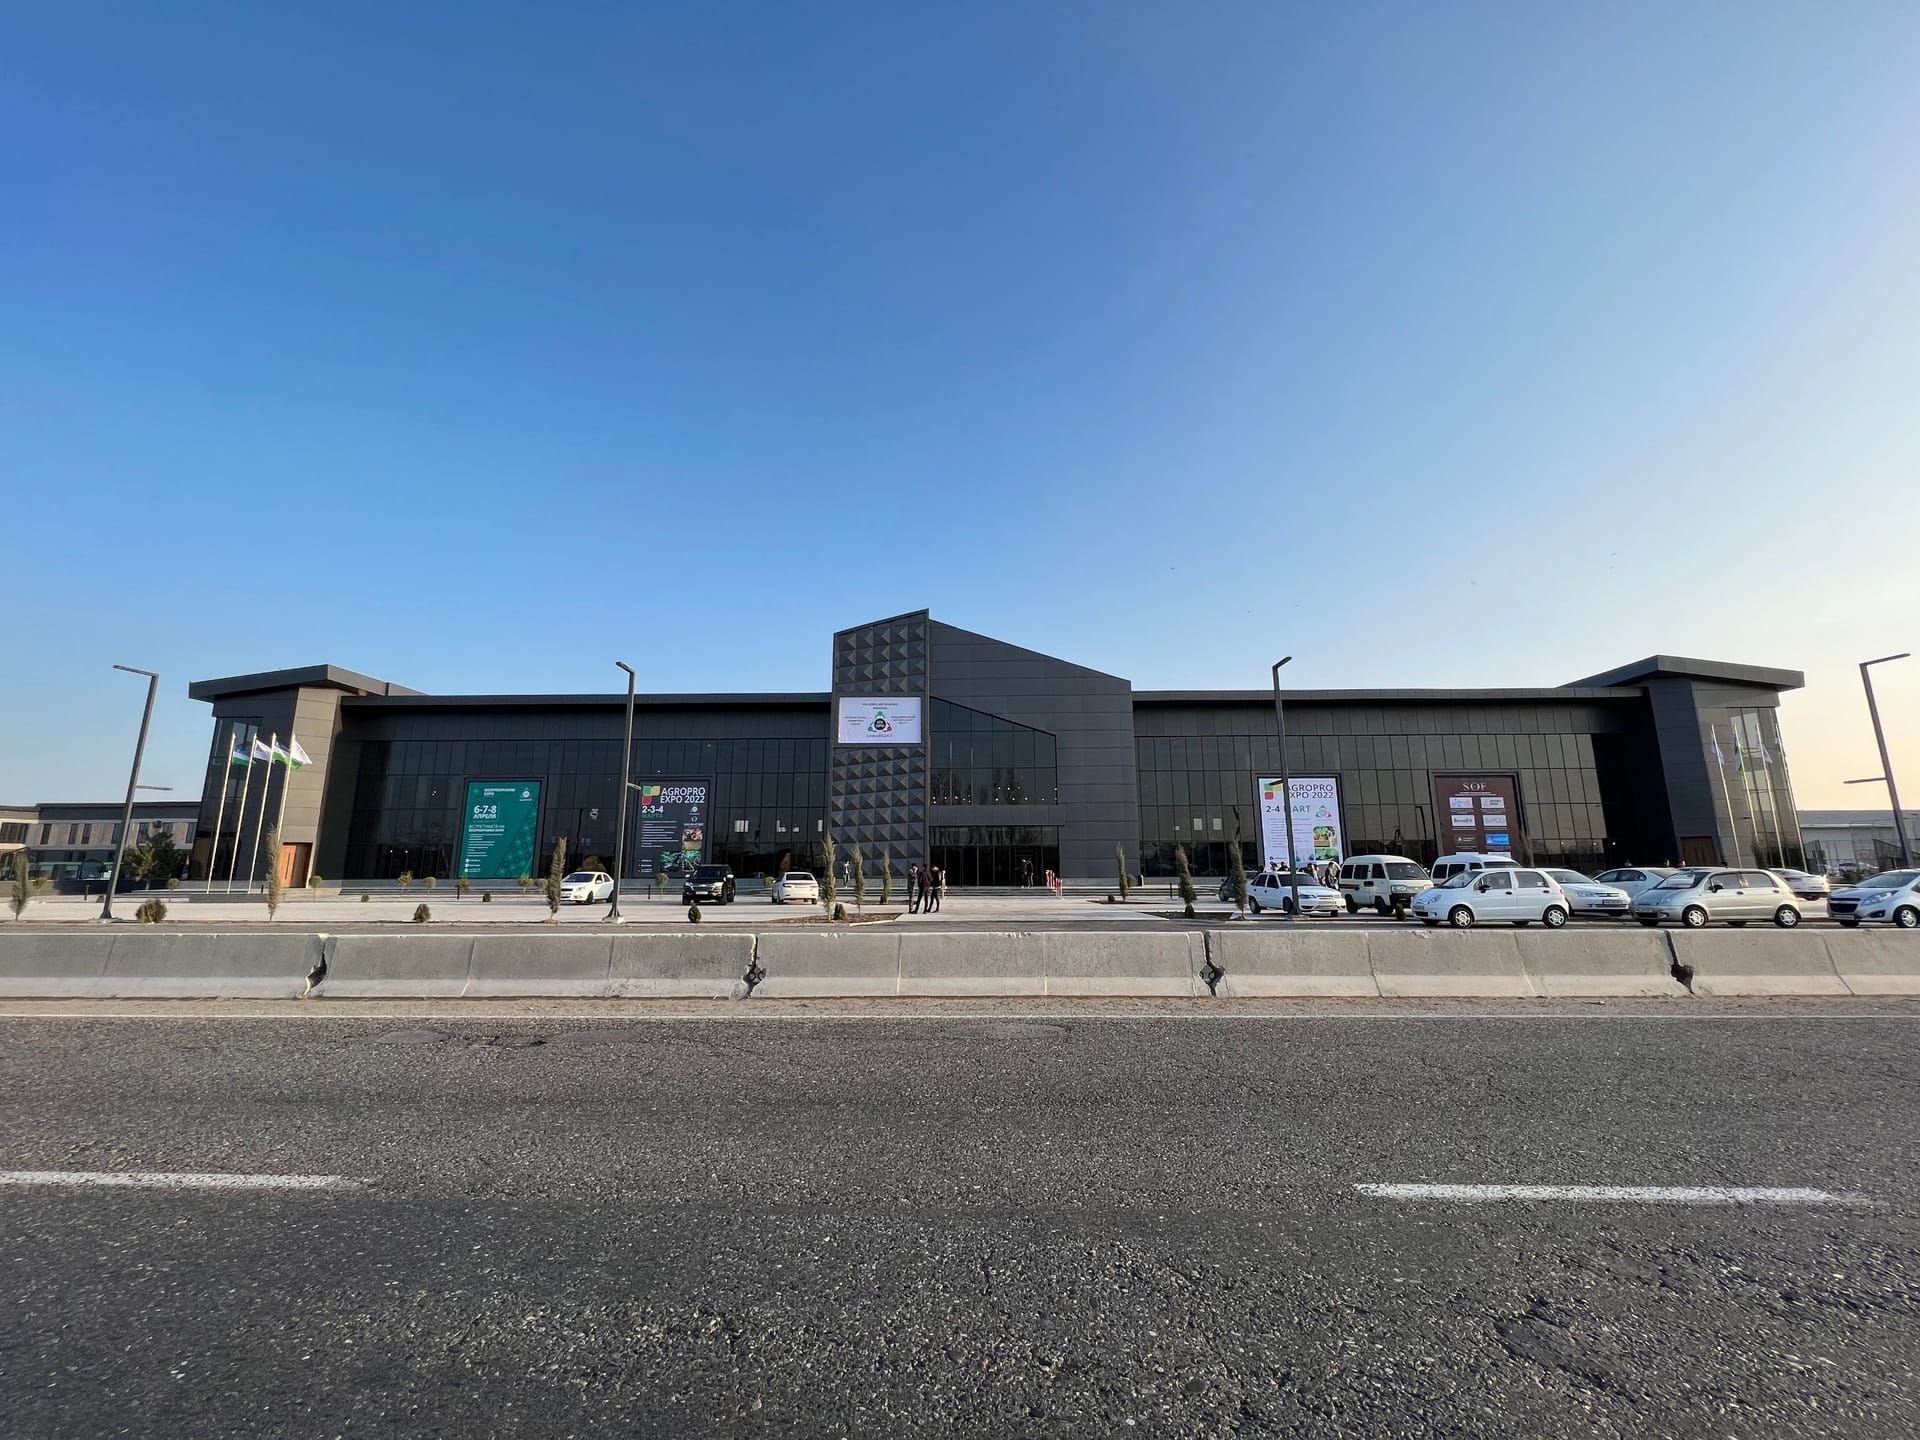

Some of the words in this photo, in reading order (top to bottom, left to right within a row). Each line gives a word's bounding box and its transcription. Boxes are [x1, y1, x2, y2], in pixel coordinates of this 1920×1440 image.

[1463, 782, 1488, 791] SOF
[661, 787, 706, 796] AGROPRO
[1312, 791, 1334, 799] 2022
[660, 796, 683, 804] EXPO
[684, 796, 705, 804] 2022
[473, 805, 497, 814] 6-7-8
[641, 805, 664, 814] 2-3-4
[1265, 805, 1280, 813] 2-4
[1292, 805, 1311, 813] ART
